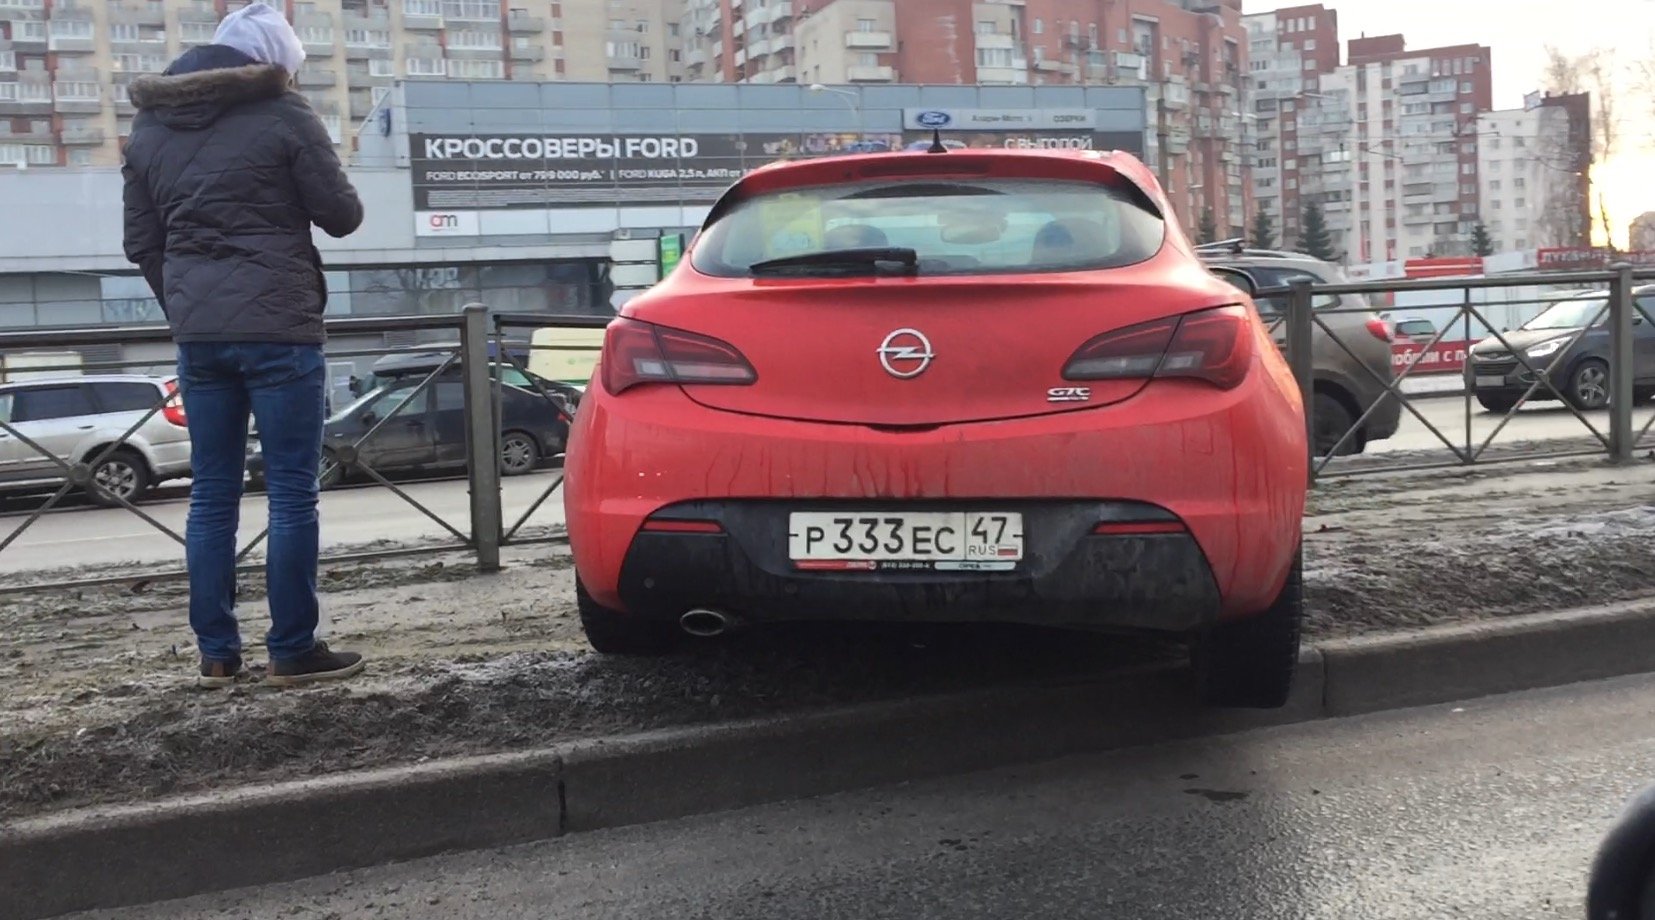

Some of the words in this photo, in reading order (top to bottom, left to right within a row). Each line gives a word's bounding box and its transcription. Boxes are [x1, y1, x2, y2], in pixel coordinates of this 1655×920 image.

[424, 138, 621, 159] КРОССОВЕРЫ
[625, 137, 699, 158] FORD
[425, 171, 456, 181] FORD
[456, 170, 519, 180] ECOSPORT
[618, 169, 647, 179] FORD
[647, 169, 678, 179] KUGA
[1046, 387, 1091, 396] GTC
[971, 516, 1008, 545] 47
[968, 545, 996, 556] RUS
